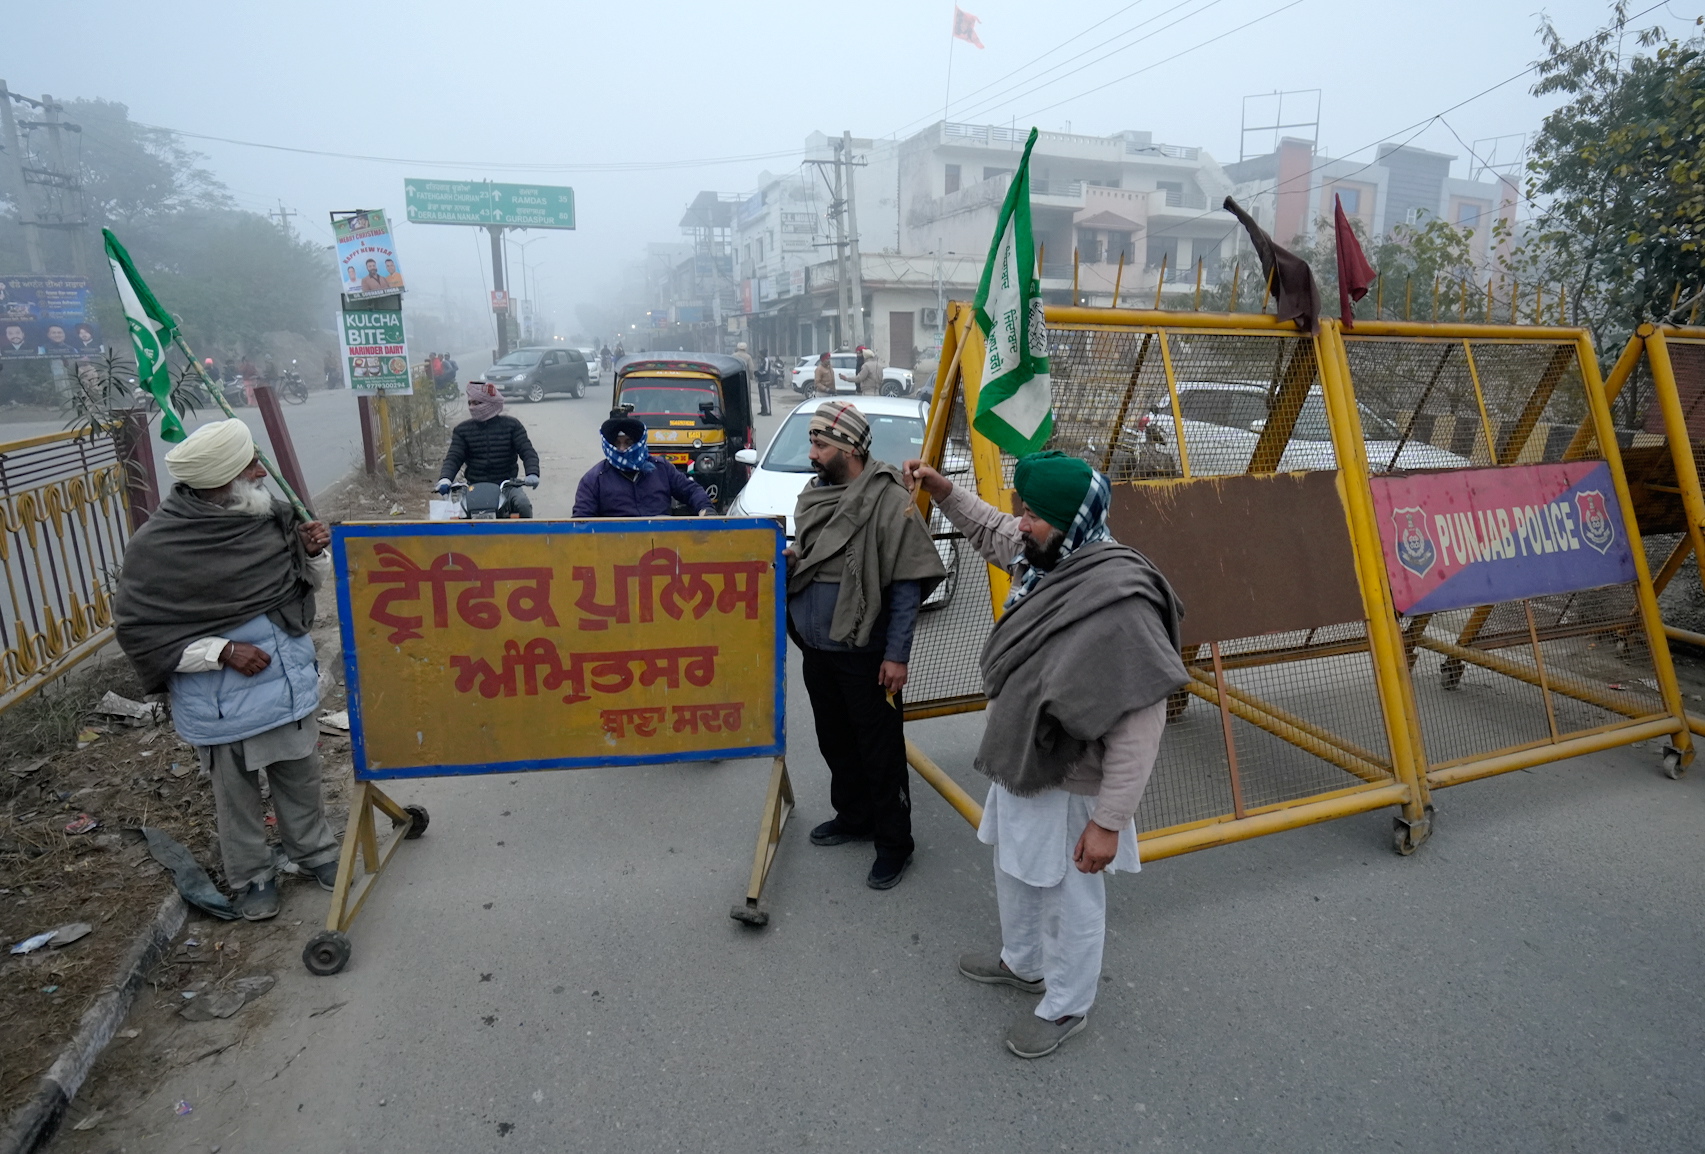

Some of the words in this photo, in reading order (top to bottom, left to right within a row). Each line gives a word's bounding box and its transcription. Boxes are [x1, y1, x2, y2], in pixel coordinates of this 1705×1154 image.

[416, 192, 452, 200] FATEHGARH
[454, 194, 480, 202] CHURIAN
[512, 196, 547, 205] RAMDAS
[418, 211, 436, 219] DERA
[438, 212, 456, 220] BABA
[457, 213, 480, 221] NANAK
[506, 215, 555, 224] GURDASPUR
[559, 212, 568, 220] 80
[343, 249, 360, 264] HAPPY
[376, 246, 393, 256] YEAR
[346, 313, 400, 327] KULCHA
[348, 328, 387, 345] BITE
[349, 346, 384, 356] NARINDER
[385, 345, 404, 355] DAIRY
[1434, 508, 1516, 566] PUNJAB
[1514, 502, 1580, 556] POLICE
[367, 543, 561, 645] ਟ੍ਰੈਫਿਕ
[572, 547, 769, 631] ਪੁਲਿਸ
[450, 637, 719, 704] ਅੰਮ੍ਰਿਤਸਰ
[600, 706, 667, 738] ਥਾਣਾ
[671, 702, 745, 735] ਸਦਰ
